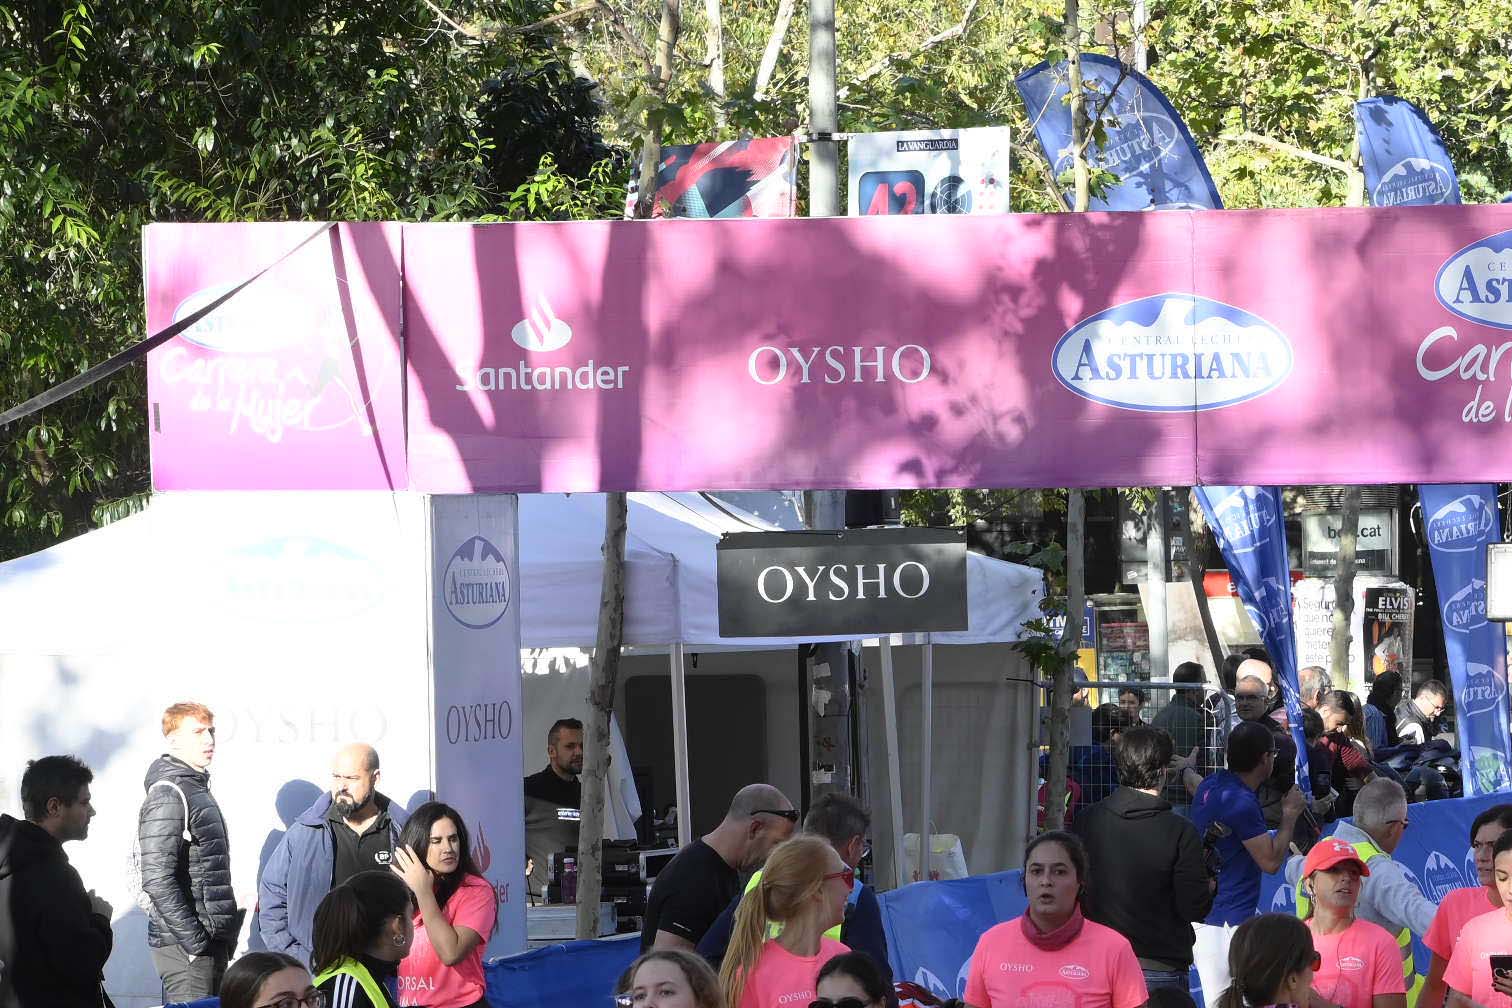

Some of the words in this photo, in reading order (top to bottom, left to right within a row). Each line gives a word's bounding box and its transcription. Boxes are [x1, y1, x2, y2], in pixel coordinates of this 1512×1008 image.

[455, 360, 630, 391] Santander
[748, 344, 932, 386] OYSHO
[1071, 338, 1273, 381] ASTURIANA
[1461, 384, 1496, 423] de
[449, 570, 507, 606] ASTURIANA
[757, 561, 931, 604] OYSHO
[1378, 596, 1409, 609] ELVIS
[446, 699, 513, 745] OYSHO
